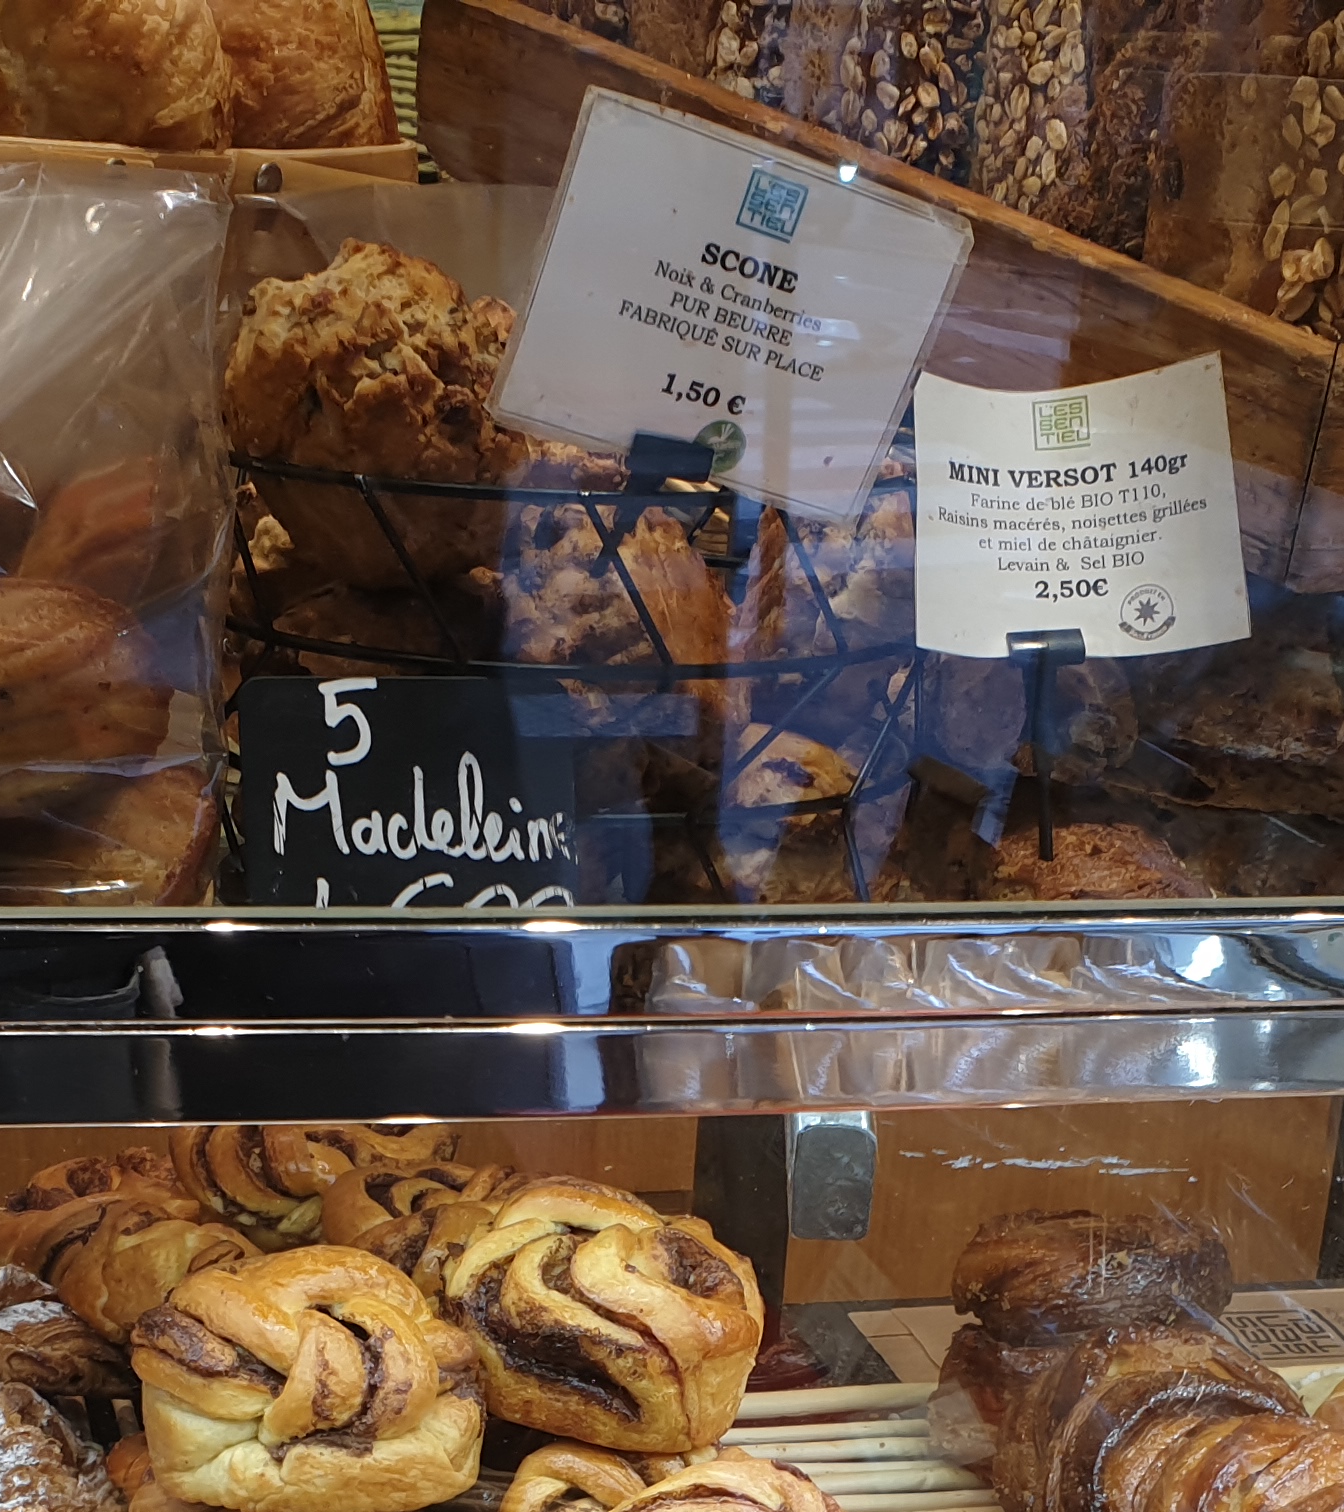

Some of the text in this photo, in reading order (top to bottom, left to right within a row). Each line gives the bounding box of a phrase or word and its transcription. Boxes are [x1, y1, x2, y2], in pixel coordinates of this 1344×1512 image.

[700, 242, 799, 294] SCONE
[654, 261, 822, 332] Noix & Cranberries
[669, 292, 793, 347] PUR BEURRE
[618, 300, 825, 382] FABRIQUÉ SUR PLACE
[660, 375, 747, 416] 1,50 €
[948, 453, 1188, 489] MINI VERSOT 140gr
[970, 493, 1021, 511] Farine
[1025, 496, 1047, 512] de
[1049, 494, 1077, 511] blé
[1080, 492, 1113, 510] BIO
[997, 550, 1145, 572] Levain & Sel BIO
[1034, 577, 1109, 602] 2,50€
[318, 676, 378, 767] 5
